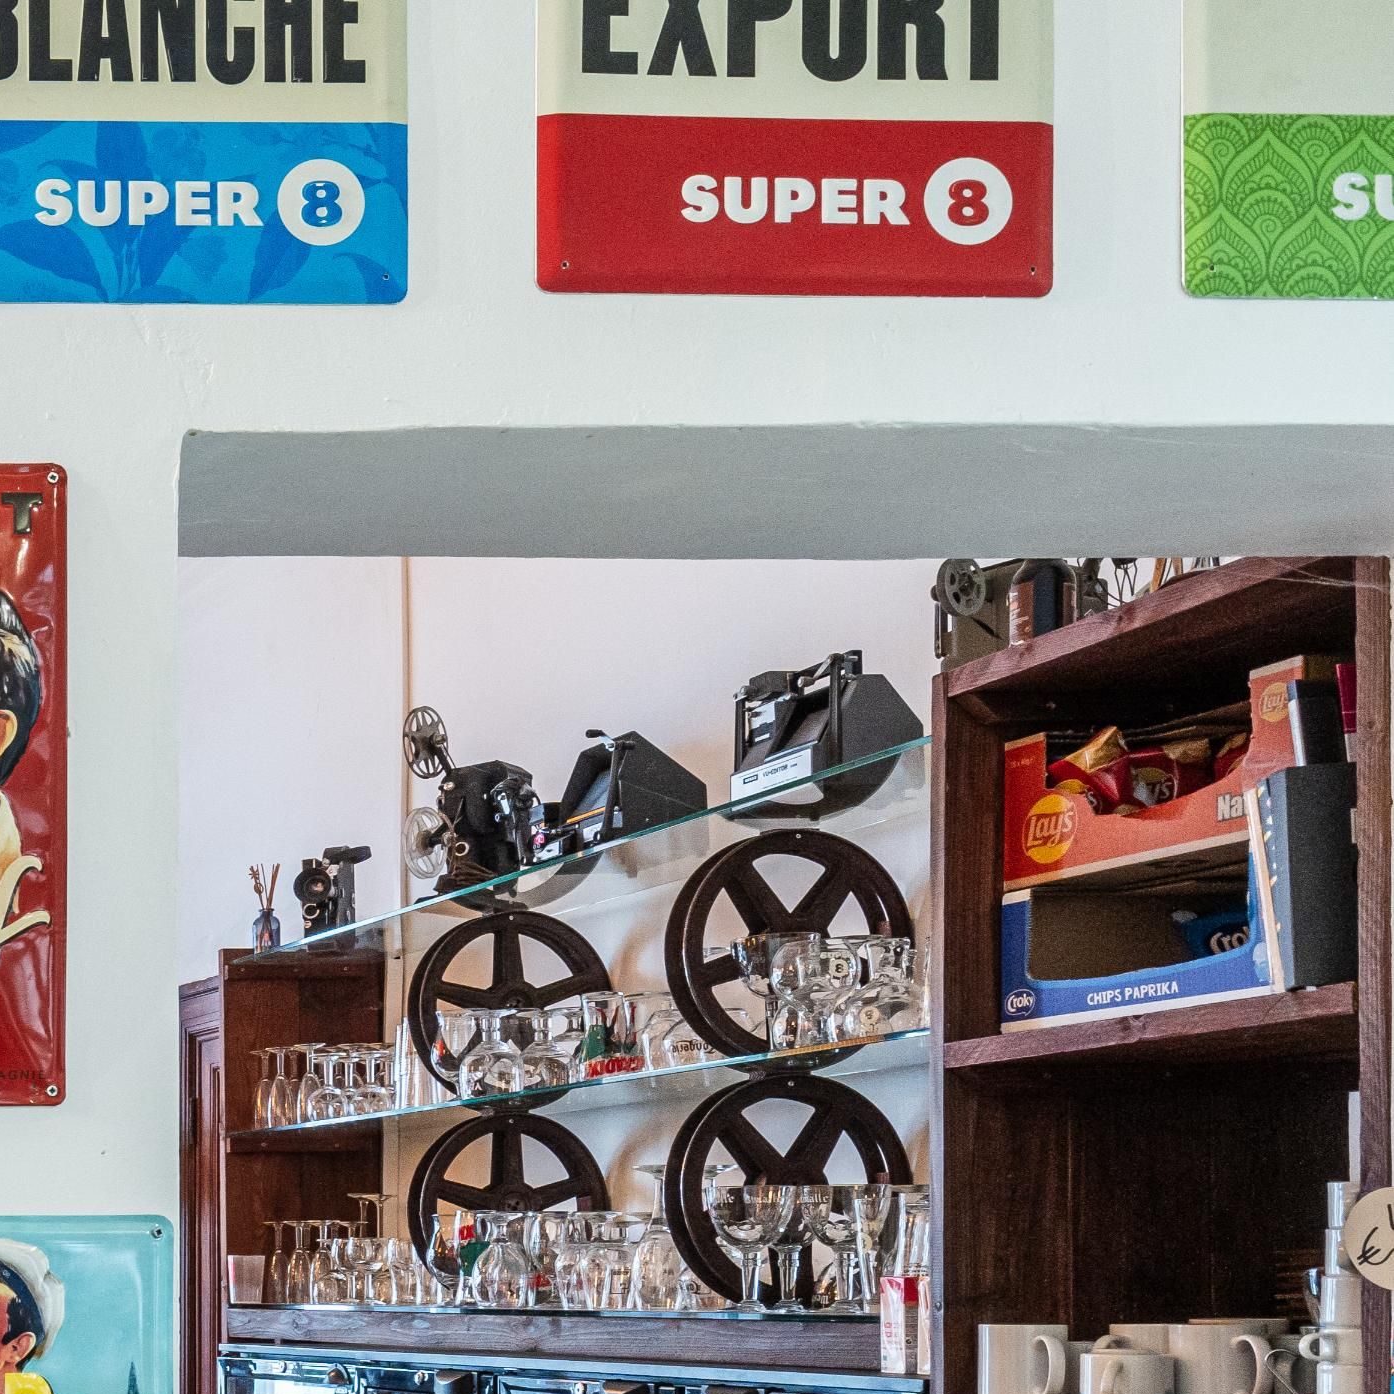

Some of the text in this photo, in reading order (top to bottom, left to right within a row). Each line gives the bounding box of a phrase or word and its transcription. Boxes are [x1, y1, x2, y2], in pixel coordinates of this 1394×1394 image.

[581, 0, 1001, 82] EXPORT
[34, 178, 344, 228] SUPER 8
[681, 174, 989, 227] SUPER 8
[1332, 172, 1394, 221] SU
[1025, 800, 1074, 848] Lay's
[1006, 990, 1035, 1013] Croky
[1087, 981, 1179, 1006] CHIPS PAPRIKA
